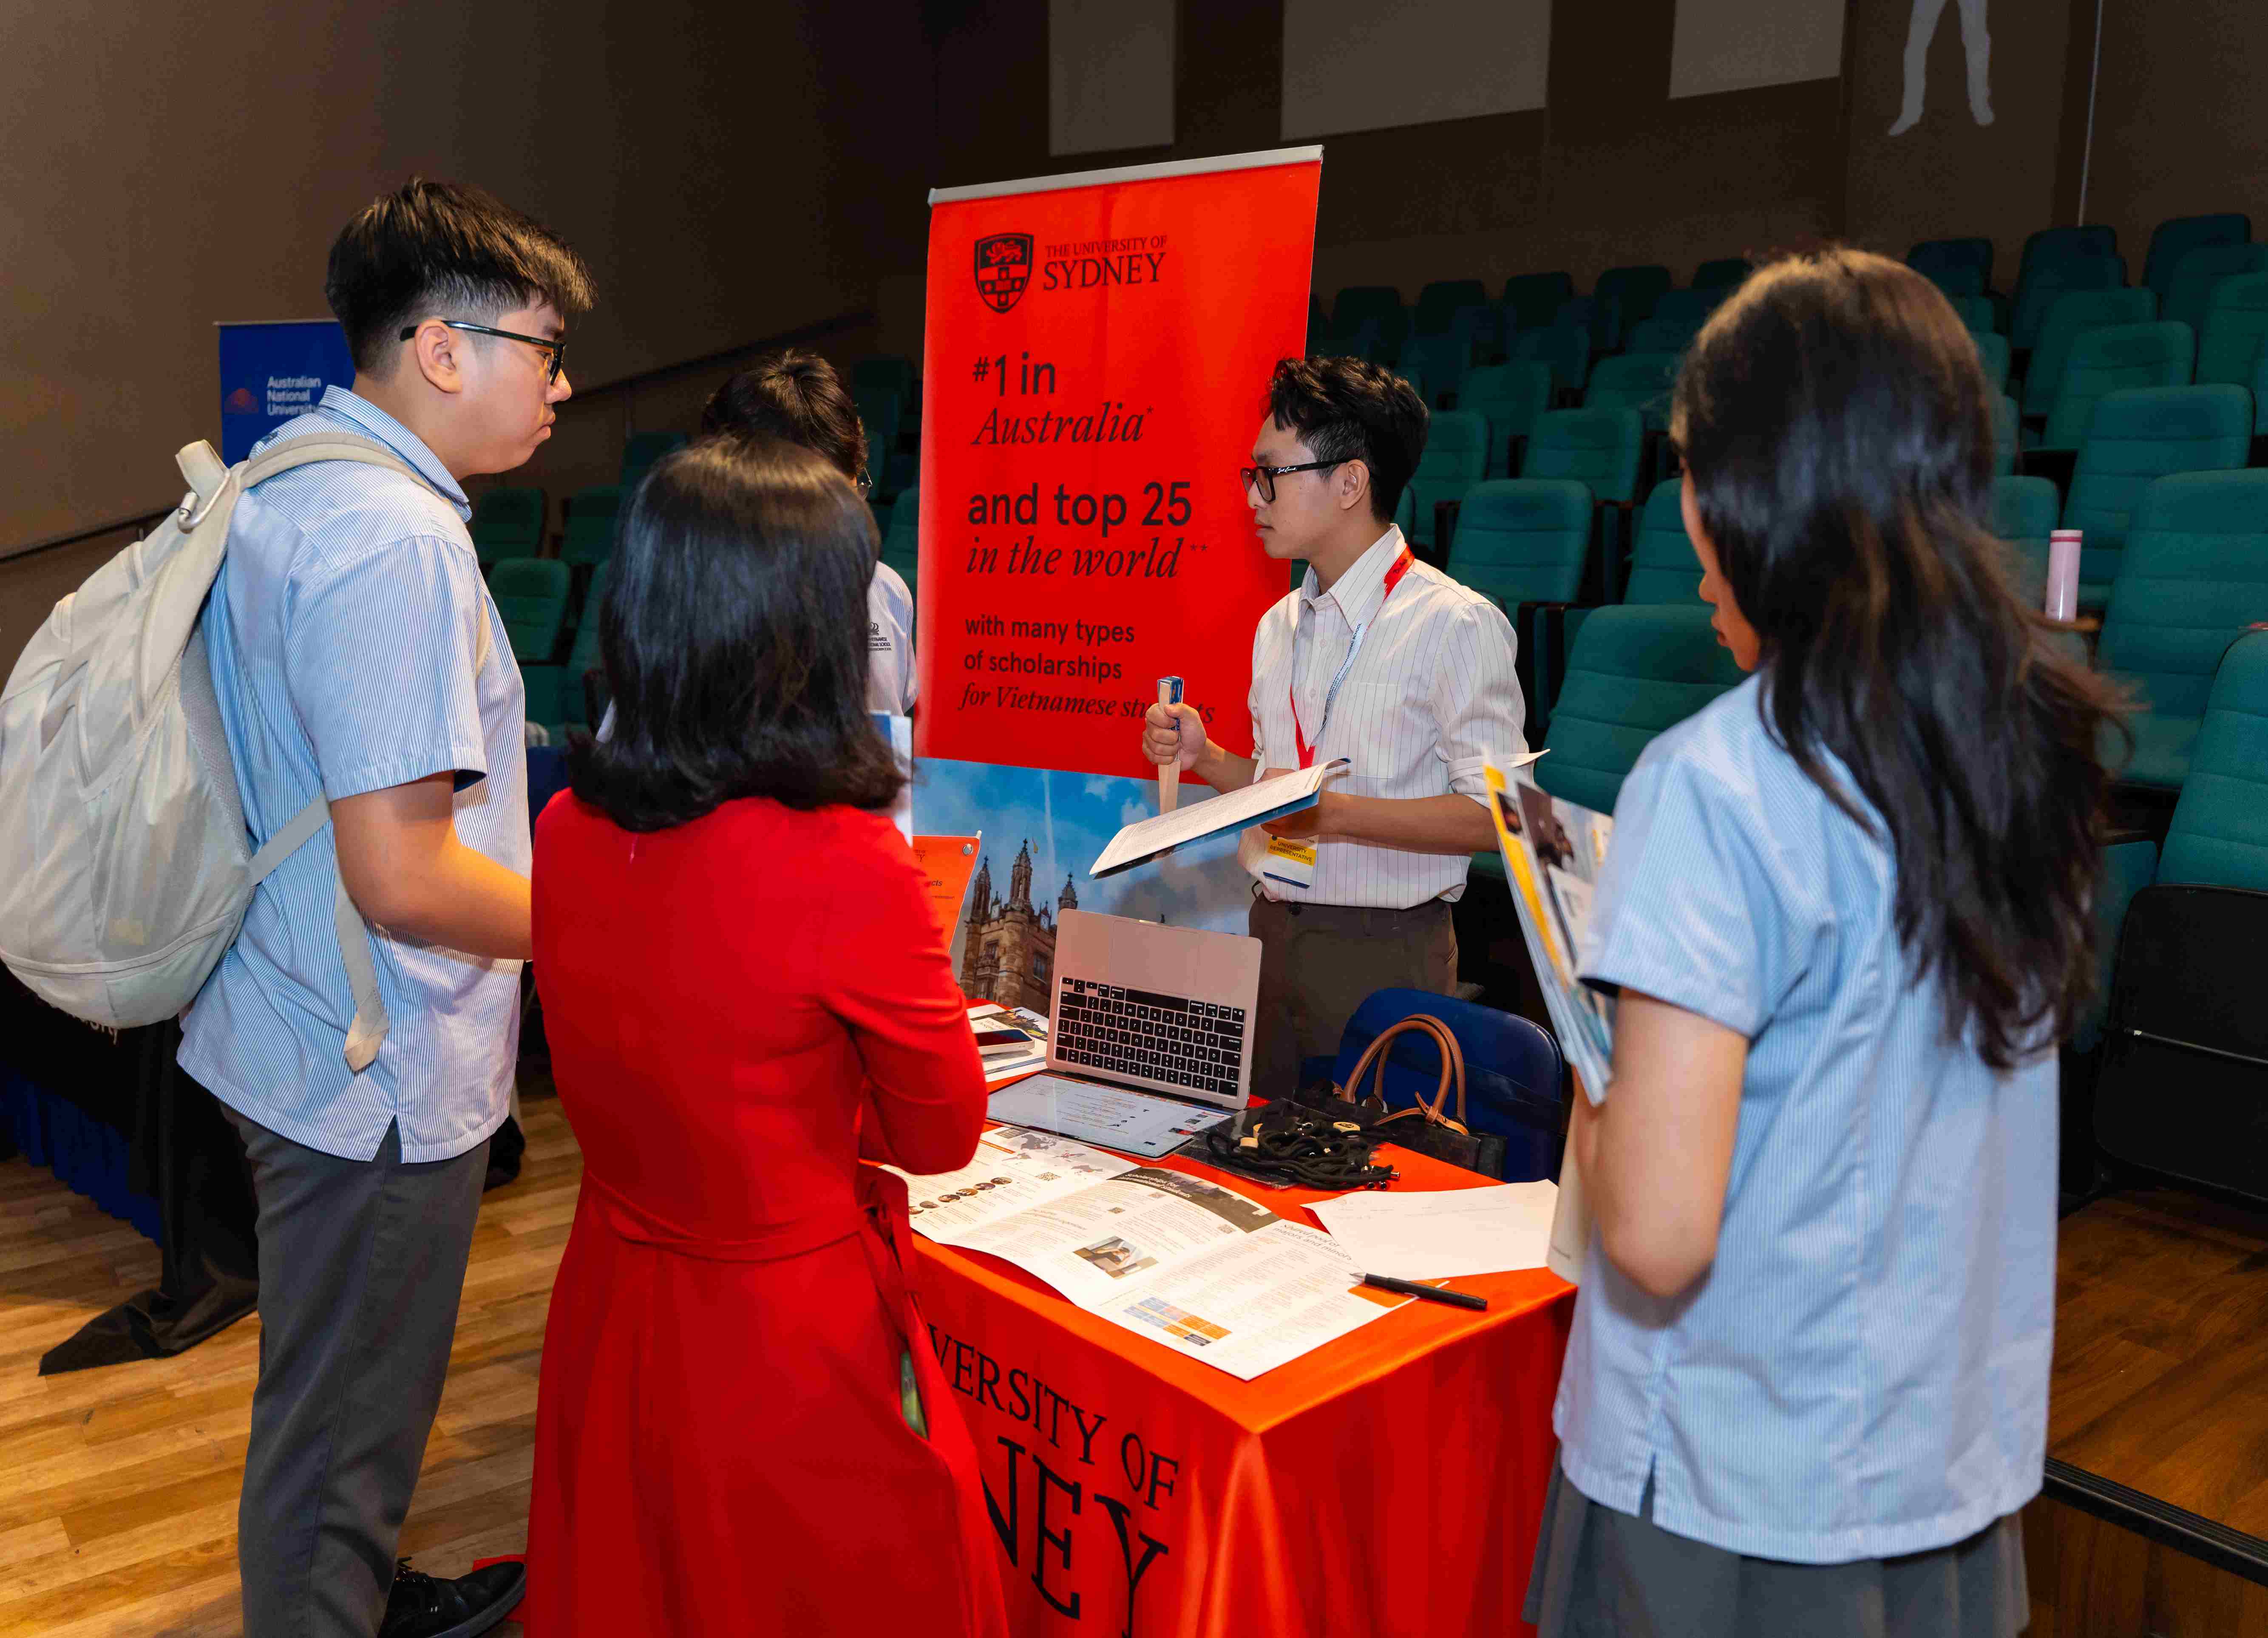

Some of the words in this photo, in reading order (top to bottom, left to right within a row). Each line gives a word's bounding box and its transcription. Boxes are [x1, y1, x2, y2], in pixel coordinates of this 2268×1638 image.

[1045, 244, 1069, 258] THE
[1073, 237, 1148, 255] UNIVERSITY
[1150, 235, 1167, 249] OF
[1043, 252, 1166, 291] SYDNEY
[267, 376, 321, 388] Australian
[972, 355, 1006, 397] #1
[1021, 352, 1055, 395] in
[267, 389, 310, 402] National
[968, 483, 1038, 525] and
[1054, 484, 1127, 538] top
[1142, 482, 1192, 527] 25
[967, 537, 998, 574] in
[1007, 535, 1062, 575] the
[965, 615, 1004, 636] with
[1011, 621, 1068, 645] many
[1075, 619, 1135, 646] types
[964, 649, 983, 670] of
[989, 652, 1122, 684] scholarships
[956, 682, 991, 711] for
[997, 686, 1115, 717] Vietnamese
[1269, 845, 1313, 862] REPRESENTATIVE
[1278, 841, 1307, 854] UNIVERSITY
[1273, 1227, 1302, 1240] majors
[1303, 1238, 1322, 1247] and
[1321, 1246, 1352, 1261] minors
[1120, 1432, 1179, 1511] OF
